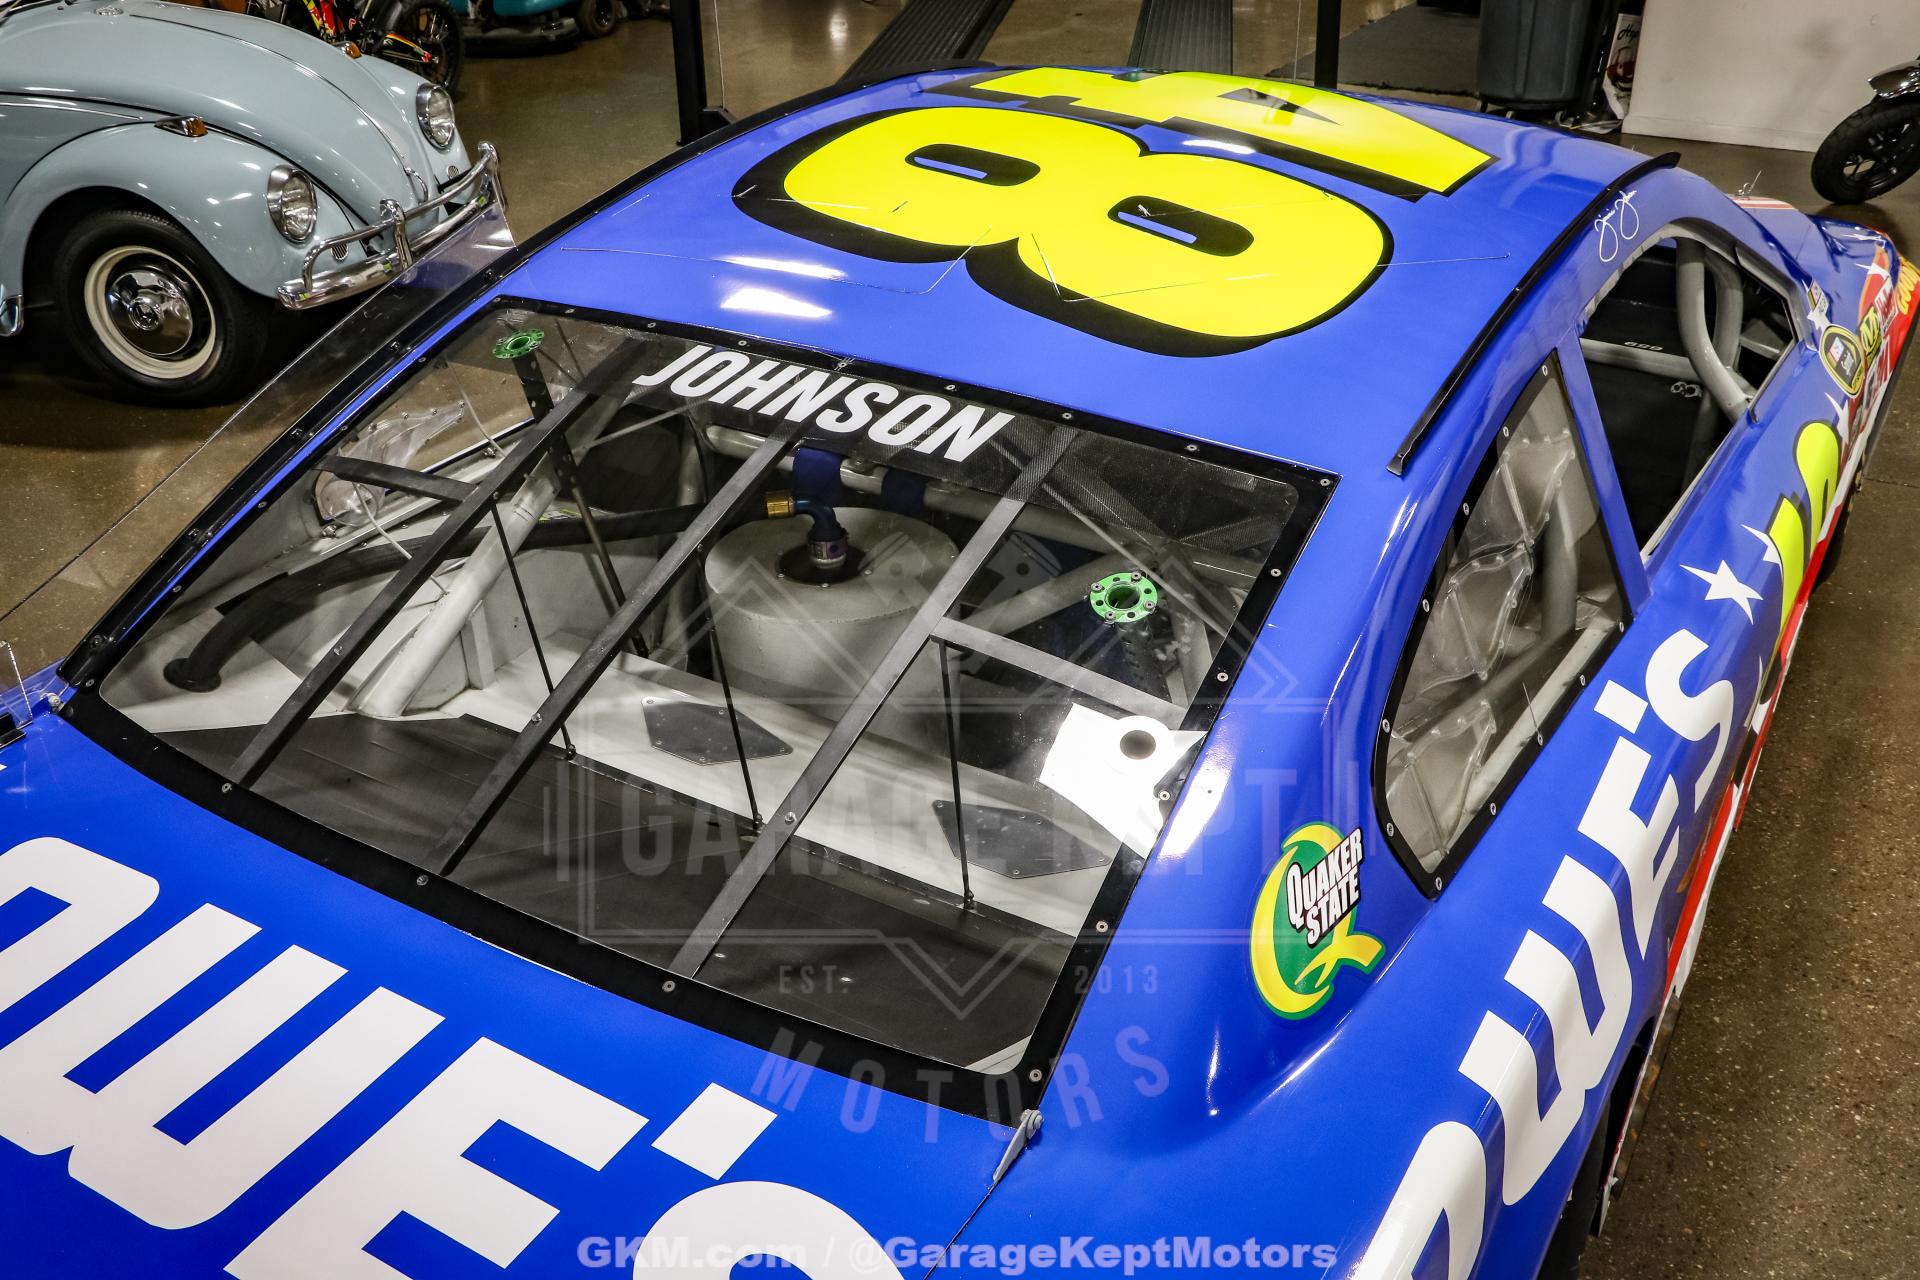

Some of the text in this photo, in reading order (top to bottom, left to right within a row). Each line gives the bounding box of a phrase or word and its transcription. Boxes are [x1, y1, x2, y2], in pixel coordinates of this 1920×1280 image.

[632, 345, 1015, 462] JOHNSON
[1287, 828, 1362, 930] QUAKER
[1307, 867, 1359, 945] STATE
